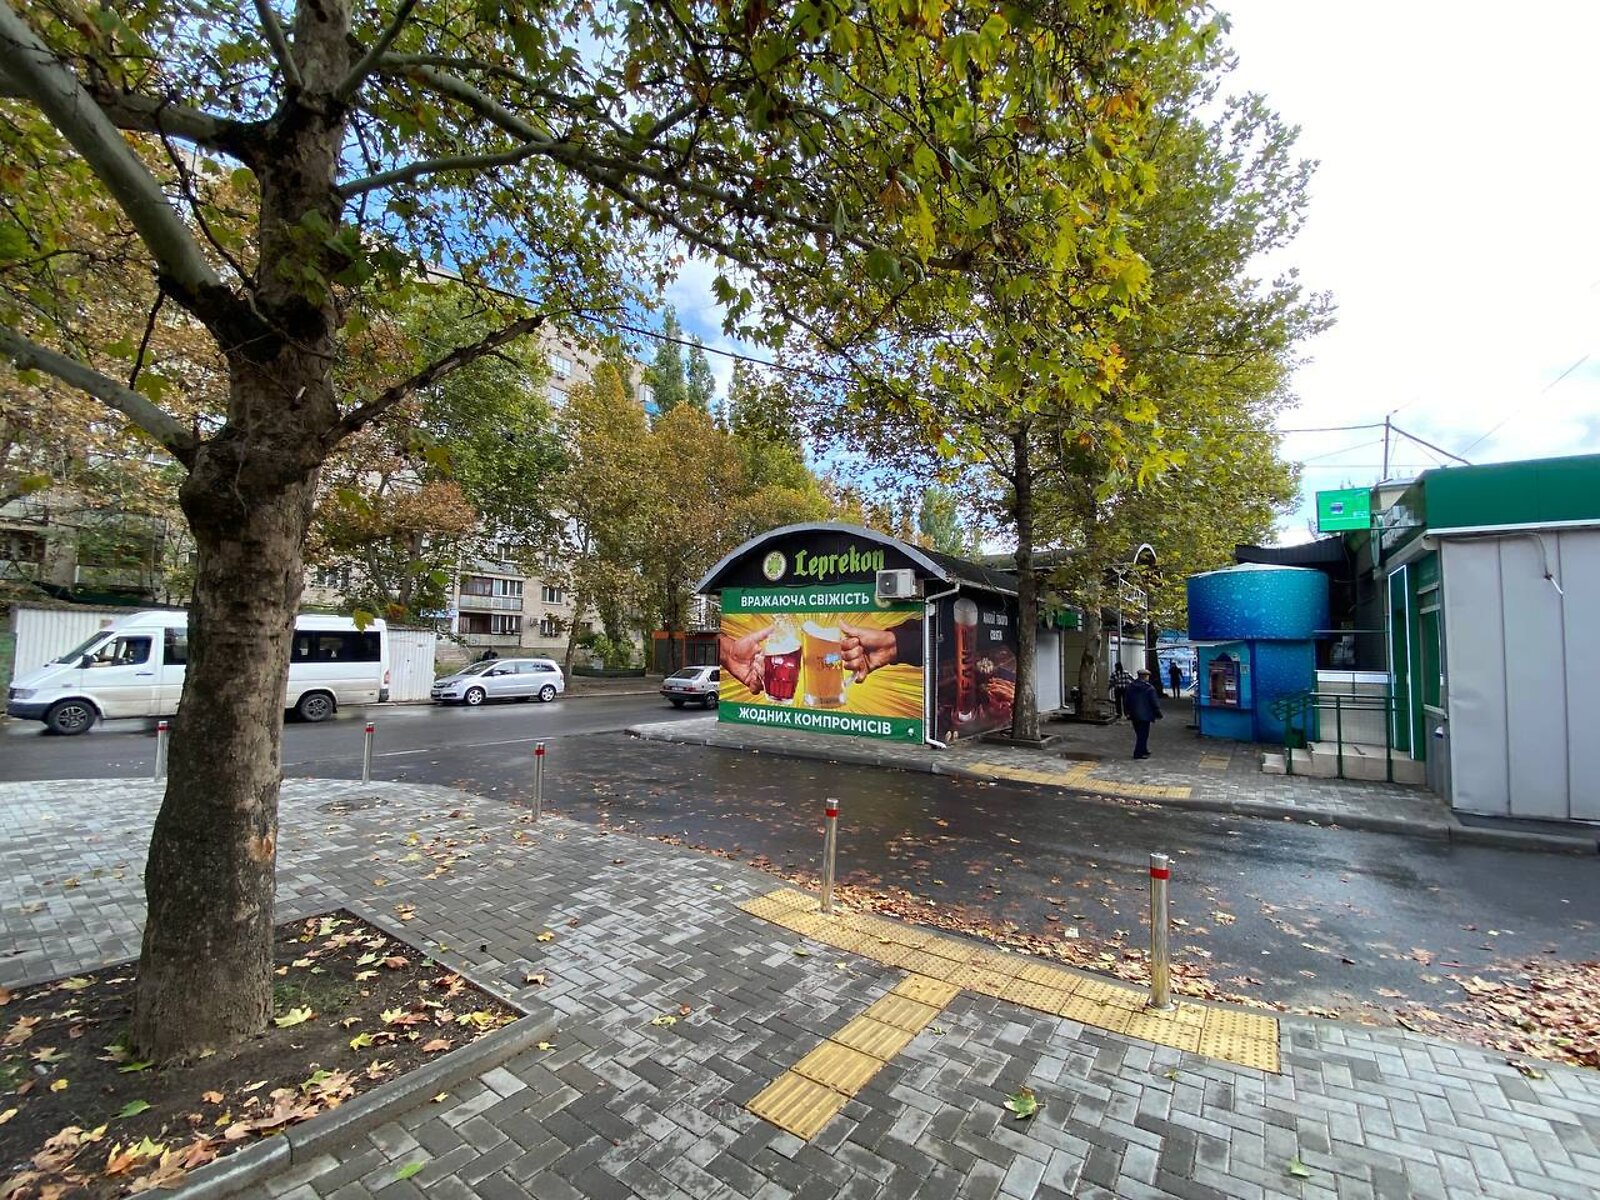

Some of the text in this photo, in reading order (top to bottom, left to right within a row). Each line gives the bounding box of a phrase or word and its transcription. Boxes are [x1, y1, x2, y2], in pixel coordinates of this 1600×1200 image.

[793, 545, 885, 580] Leprekon
[740, 592, 870, 607] ВРАЖАЮЧА СВІЖІСТЬ
[739, 707, 892, 735] ЖОДНИХ КОМПРОМІСІВ
